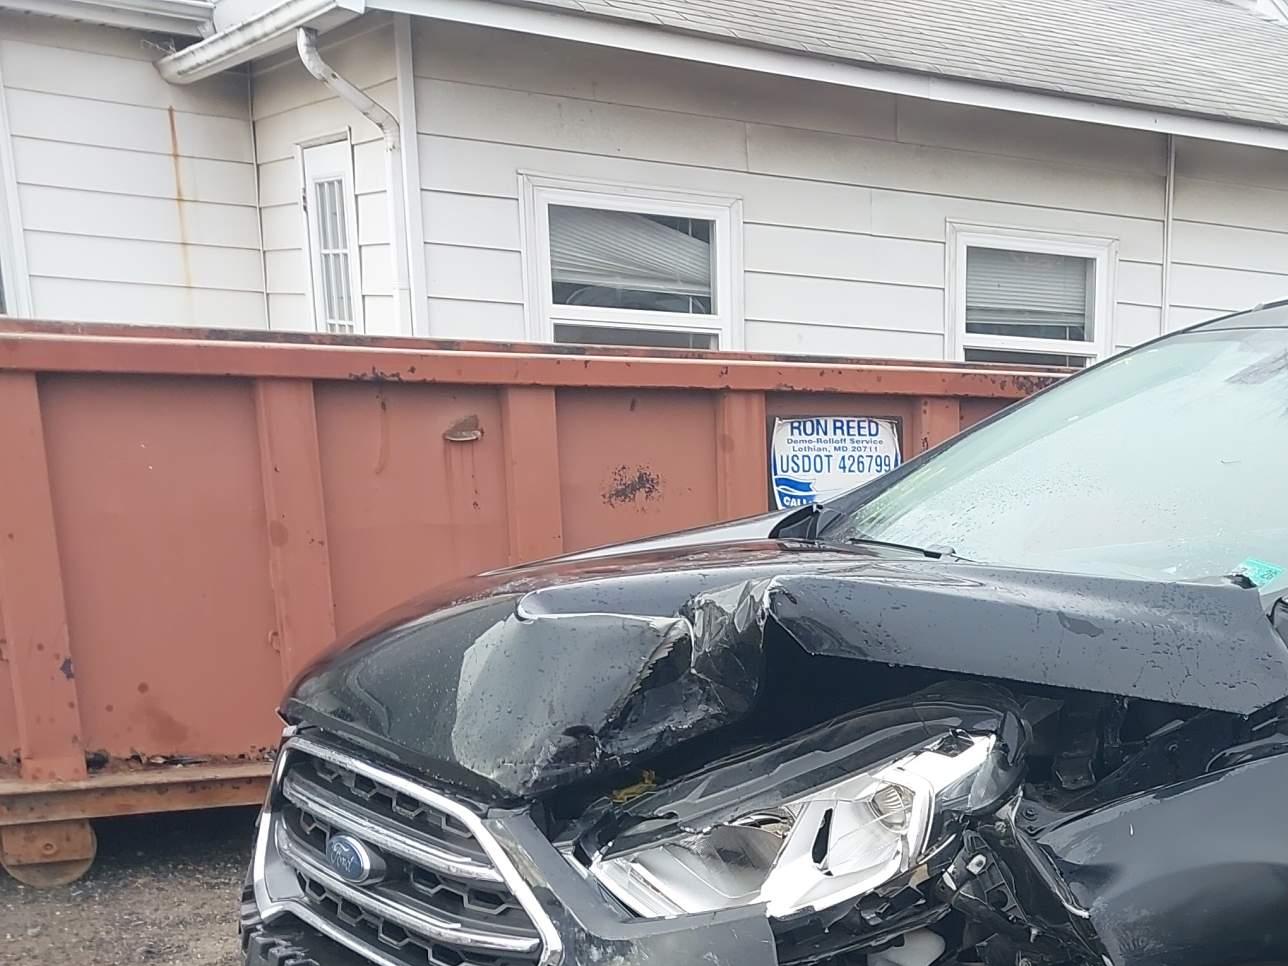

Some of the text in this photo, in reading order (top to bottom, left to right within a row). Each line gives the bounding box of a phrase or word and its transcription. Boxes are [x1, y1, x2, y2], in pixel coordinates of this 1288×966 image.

[790, 419, 880, 437] RON REED
[780, 455, 891, 473] USDOT 426799
[331, 842, 355, 873] Ford
